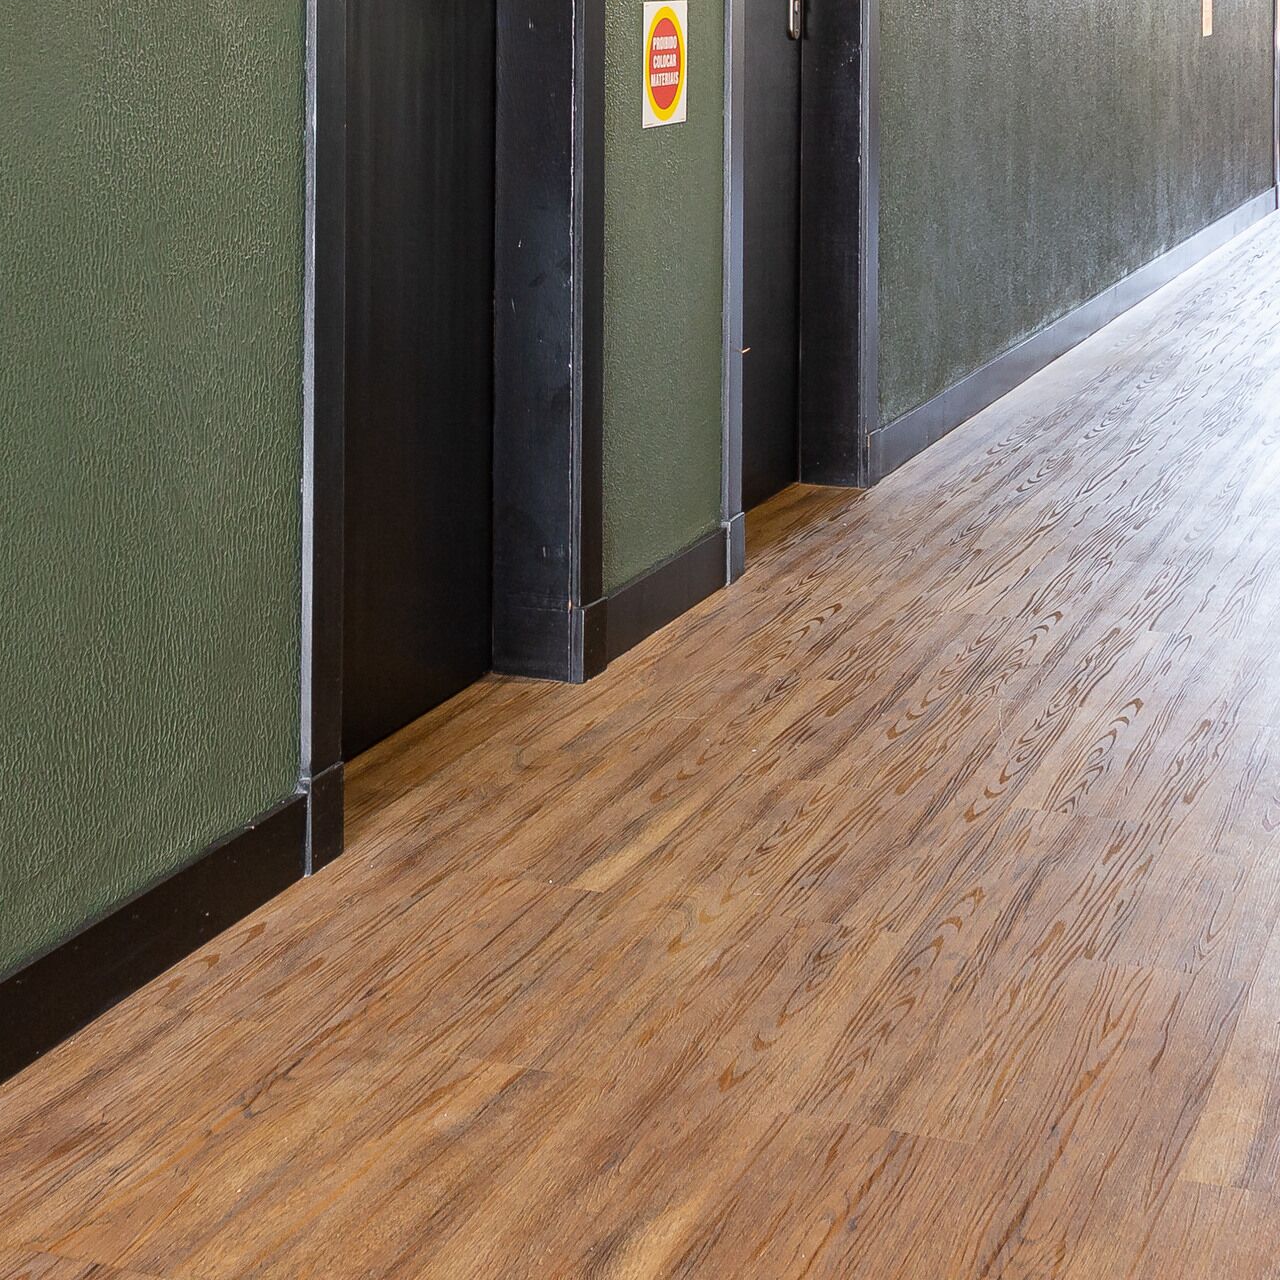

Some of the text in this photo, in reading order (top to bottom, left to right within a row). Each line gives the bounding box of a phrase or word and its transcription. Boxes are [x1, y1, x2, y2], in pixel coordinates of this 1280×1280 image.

[653, 35, 677, 50] PROIBIDO
[653, 53, 677, 69] COLOCAR
[651, 71, 679, 87] MATERIAIS
